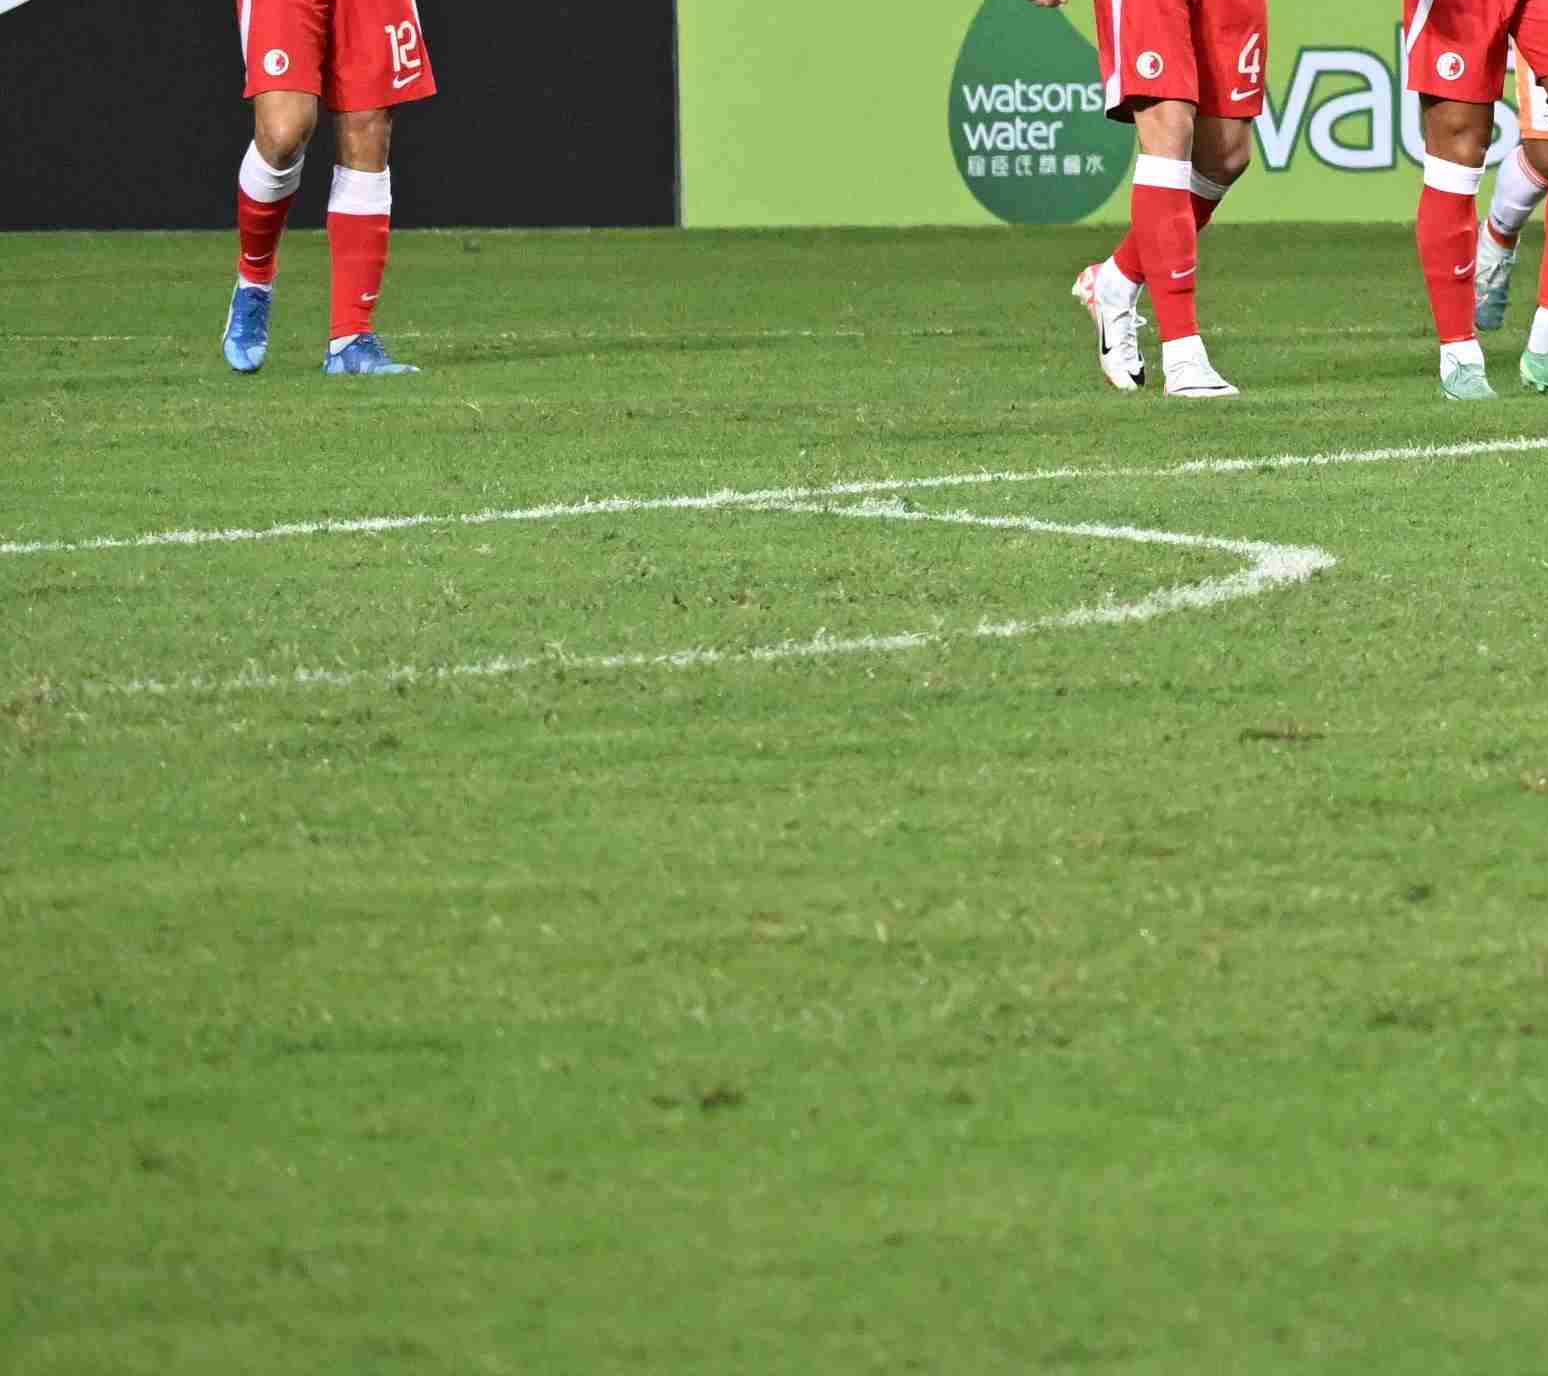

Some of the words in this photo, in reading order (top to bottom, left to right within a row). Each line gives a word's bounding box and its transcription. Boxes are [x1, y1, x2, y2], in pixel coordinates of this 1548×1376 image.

[385, 19, 419, 73] 12
[1238, 34, 1260, 83] 4
[963, 79, 1104, 113] watsons
[963, 116, 1063, 151] water
